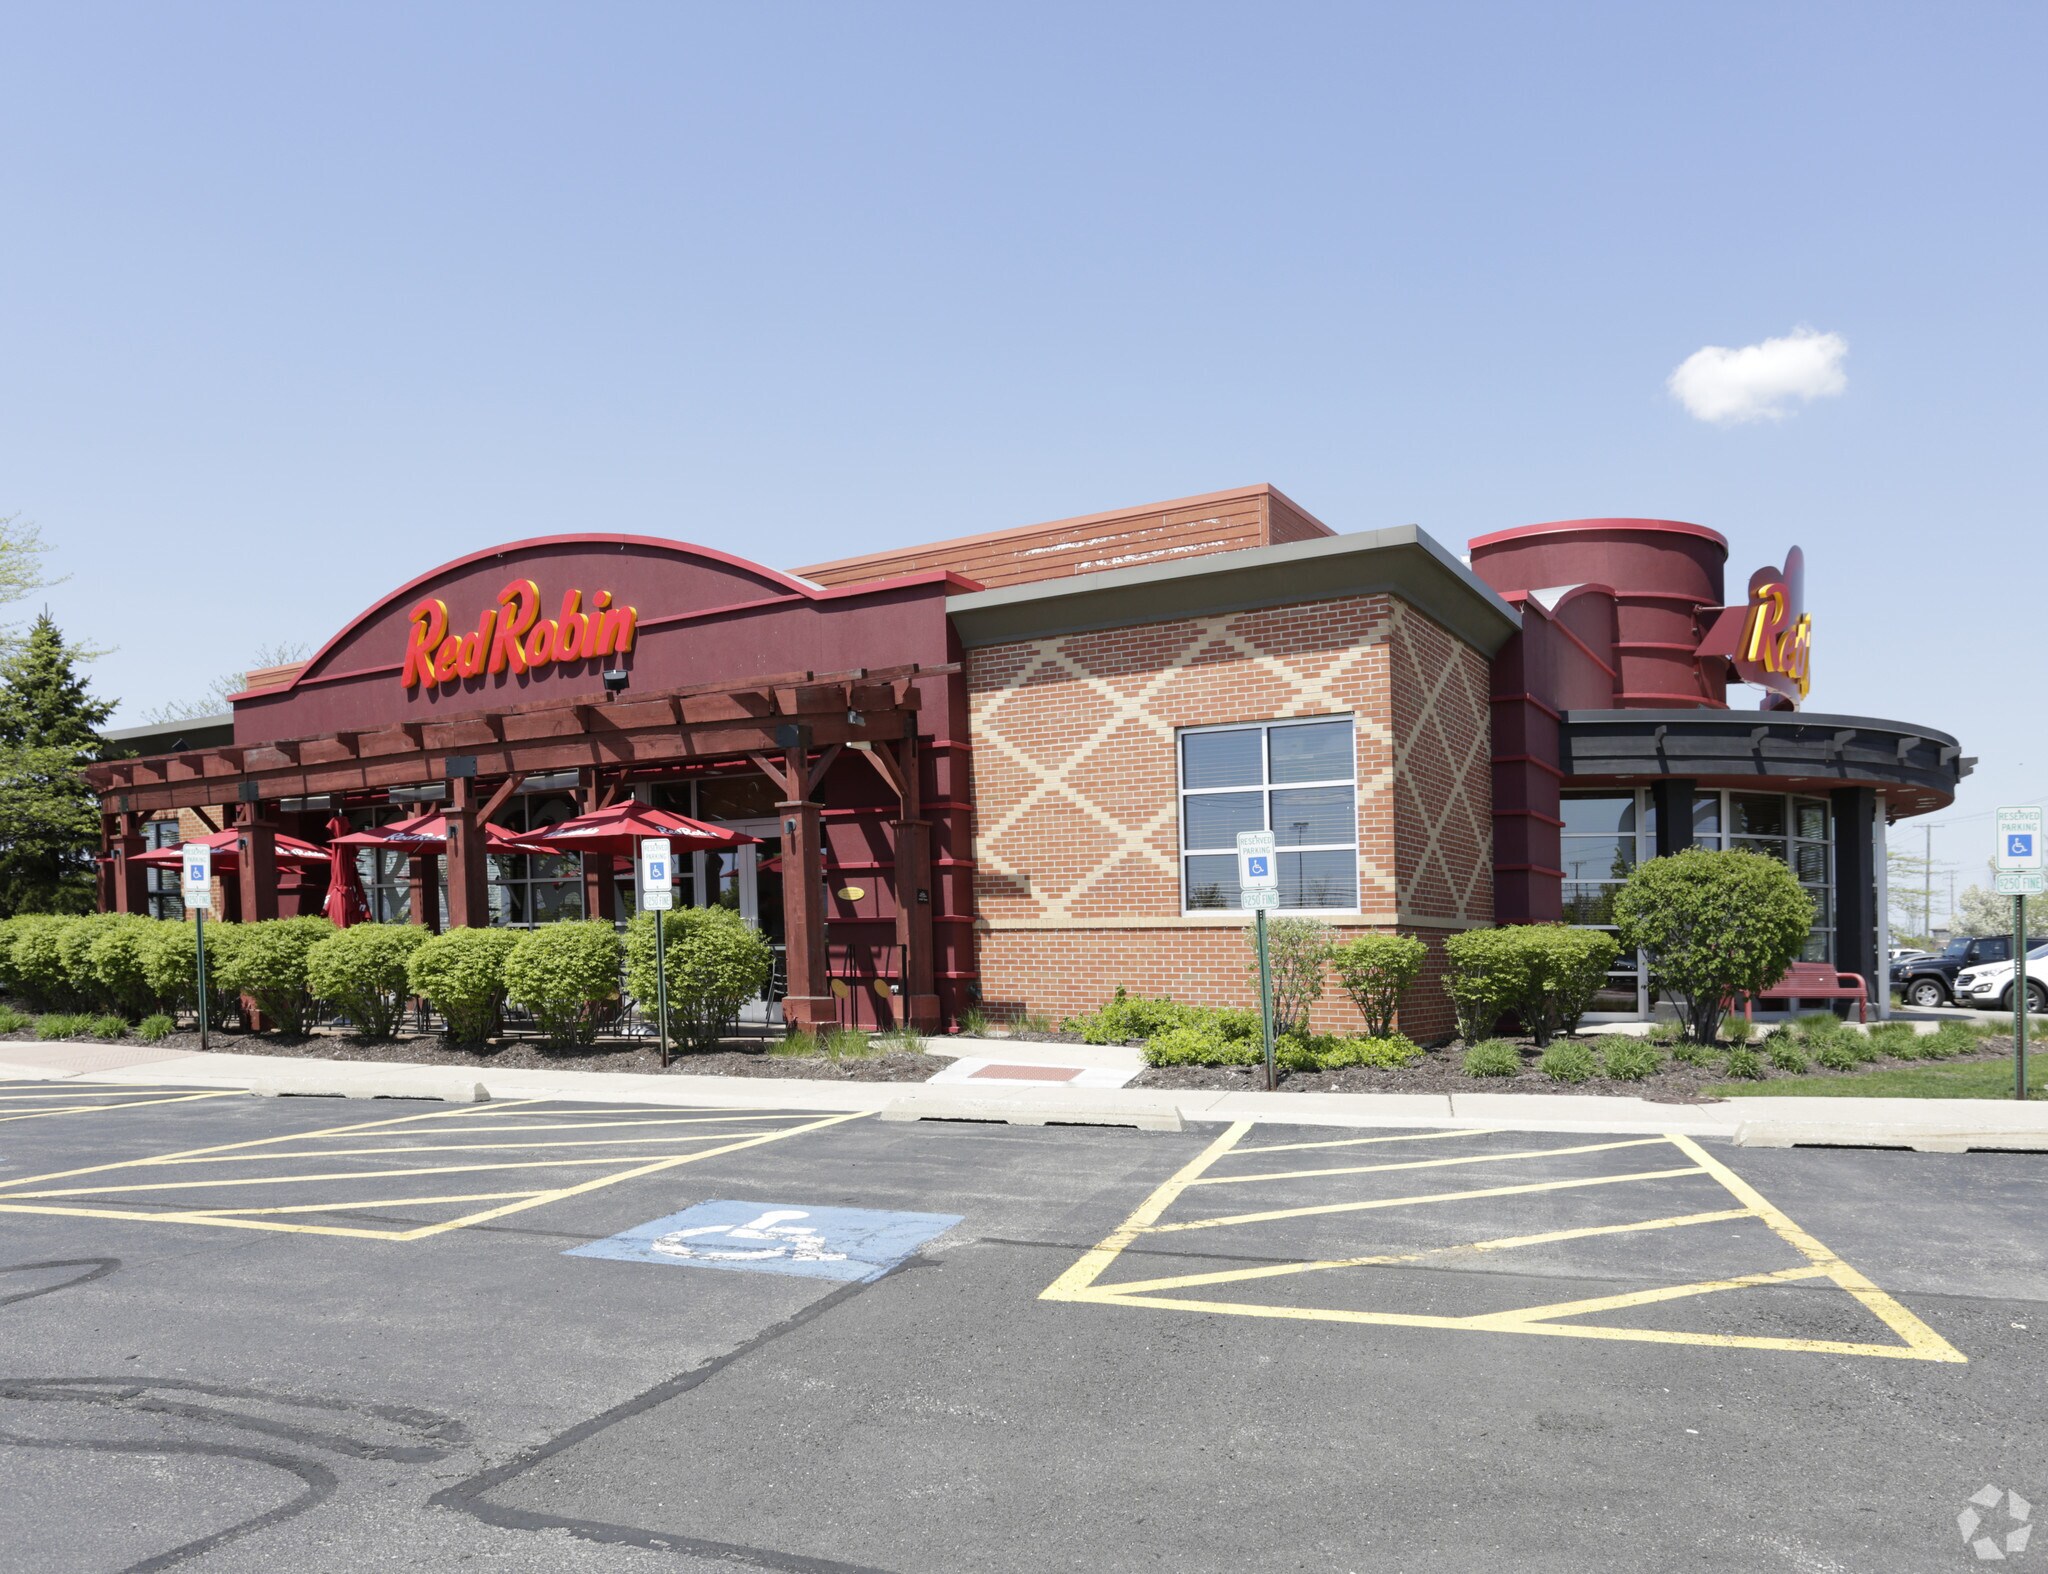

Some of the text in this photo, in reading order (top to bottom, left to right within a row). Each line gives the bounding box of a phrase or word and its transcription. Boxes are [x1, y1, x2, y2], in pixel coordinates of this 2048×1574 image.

[1998, 811, 2040, 821] RESERVED
[2001, 823, 2038, 832] PARKING
[1240, 836, 1272, 846] RESERVED
[1243, 846, 1271, 855] PARKING
[1999, 876, 2041, 890] $250 FINE
[1244, 893, 1277, 906] $250 FINE
